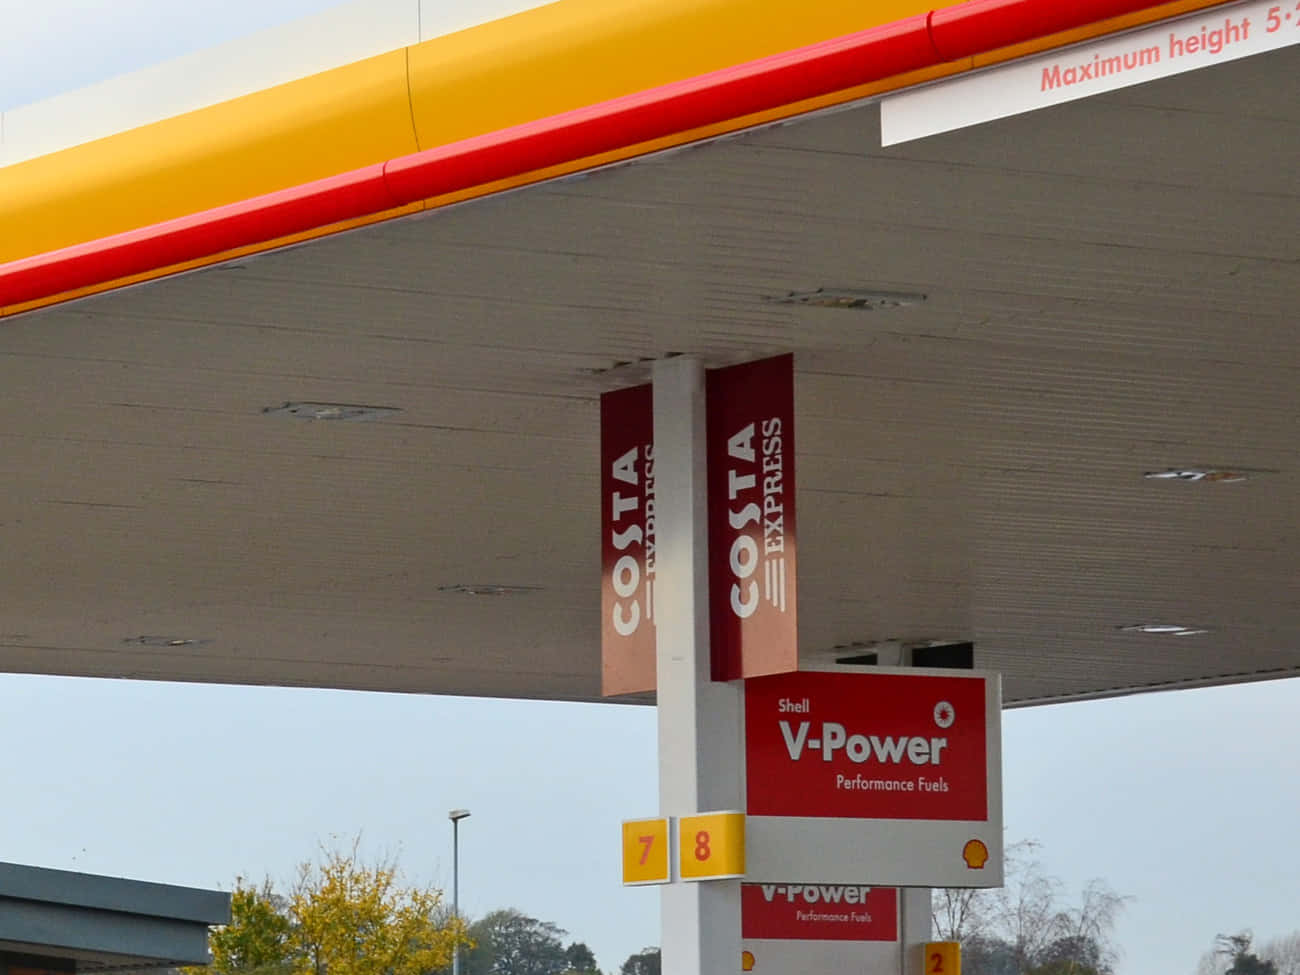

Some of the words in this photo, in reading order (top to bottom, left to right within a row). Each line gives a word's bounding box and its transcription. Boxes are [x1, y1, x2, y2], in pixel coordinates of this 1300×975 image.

[1040, 41, 1160, 92] Maximum
[1168, 17, 1251, 61] height
[762, 417, 784, 556] EXPRESS
[728, 423, 761, 618] COSTA
[612, 446, 643, 636] COSTA
[778, 698, 810, 713] Shell
[778, 720, 948, 766] V-Power
[836, 773, 914, 791] Performance
[918, 776, 949, 793] Fuels
[638, 835, 655, 866] 7
[694, 830, 711, 862] 8
[796, 910, 848, 923] Performance
[851, 911, 873, 923] Fuels
[930, 953, 944, 973] 2
